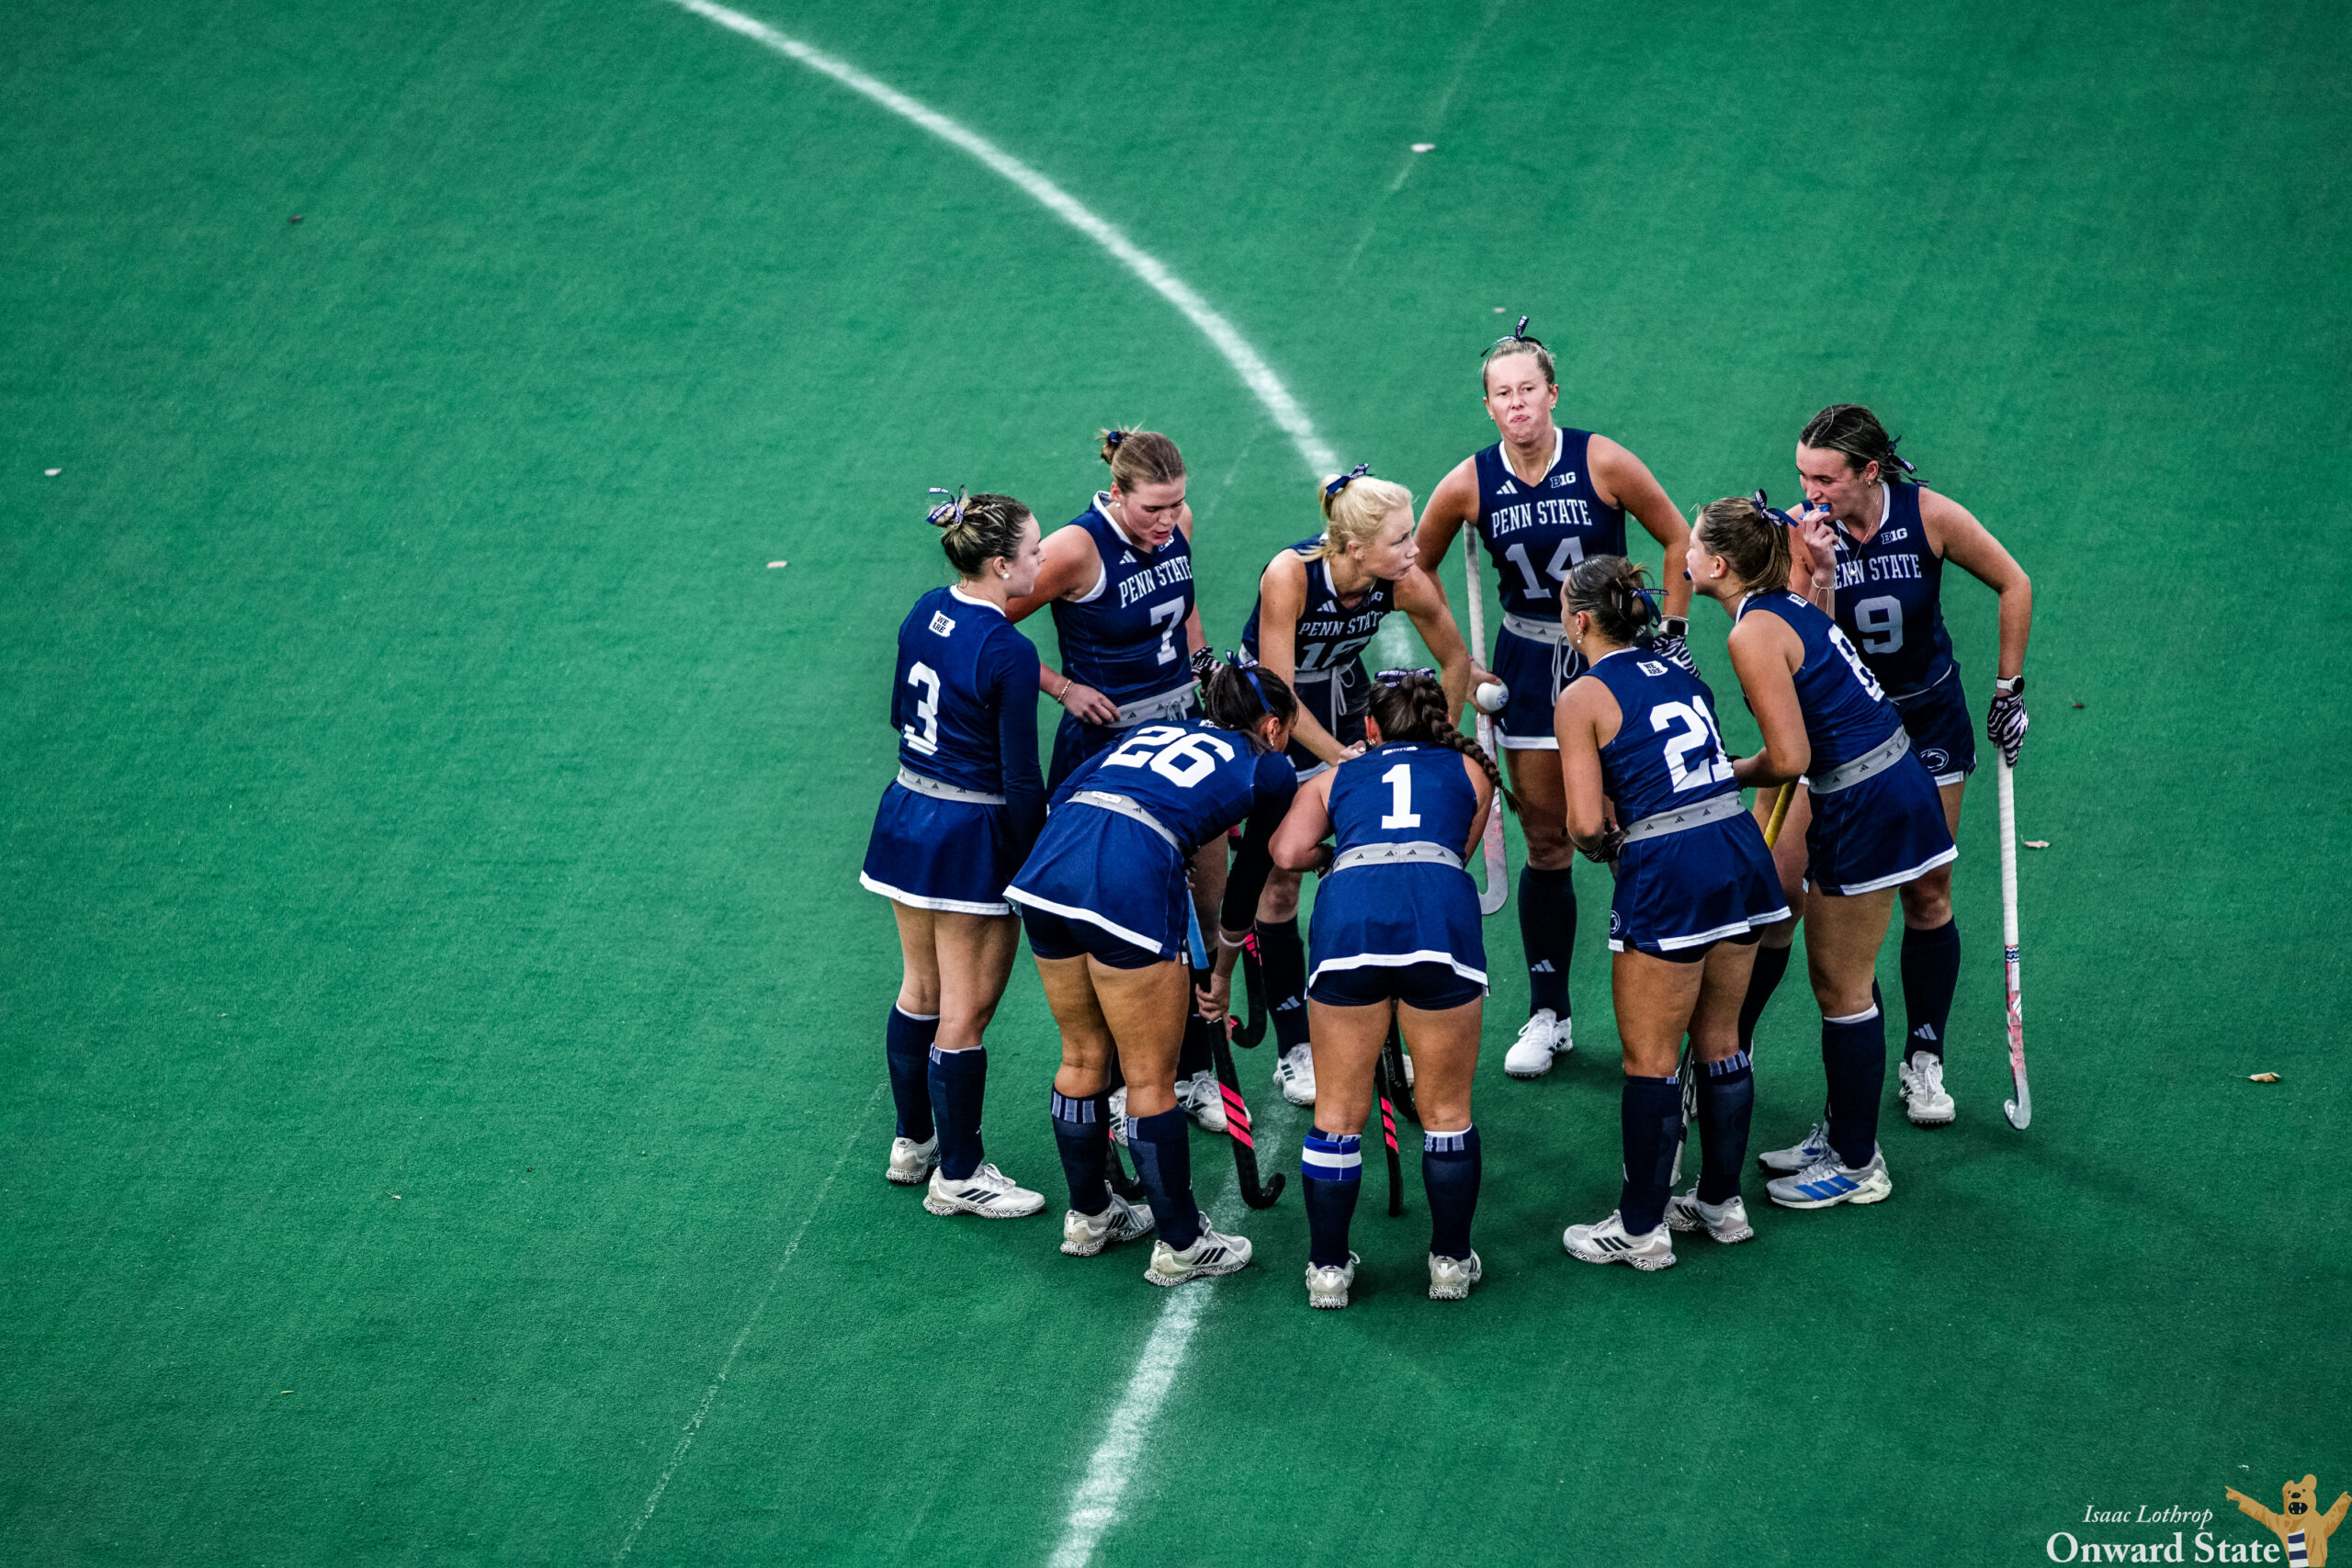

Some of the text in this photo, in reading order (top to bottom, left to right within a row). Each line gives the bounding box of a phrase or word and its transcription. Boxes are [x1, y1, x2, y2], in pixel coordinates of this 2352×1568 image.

[1491, 499, 1593, 539] PENN STATE
[1118, 569, 1157, 609] PENN
[1505, 536, 1585, 600] 14
[1834, 553, 1922, 590] ENN STATE
[932, 621, 946, 634] ARE
[937, 615, 950, 626] WE
[1149, 595, 1185, 666] 7
[1297, 610, 1384, 637] PENN STAT
[1855, 594, 1904, 655] 9
[904, 660, 941, 756] 3
[1101, 725, 1236, 788] 26
[1649, 695, 1735, 794] 21
[1381, 763, 1421, 829] 1
